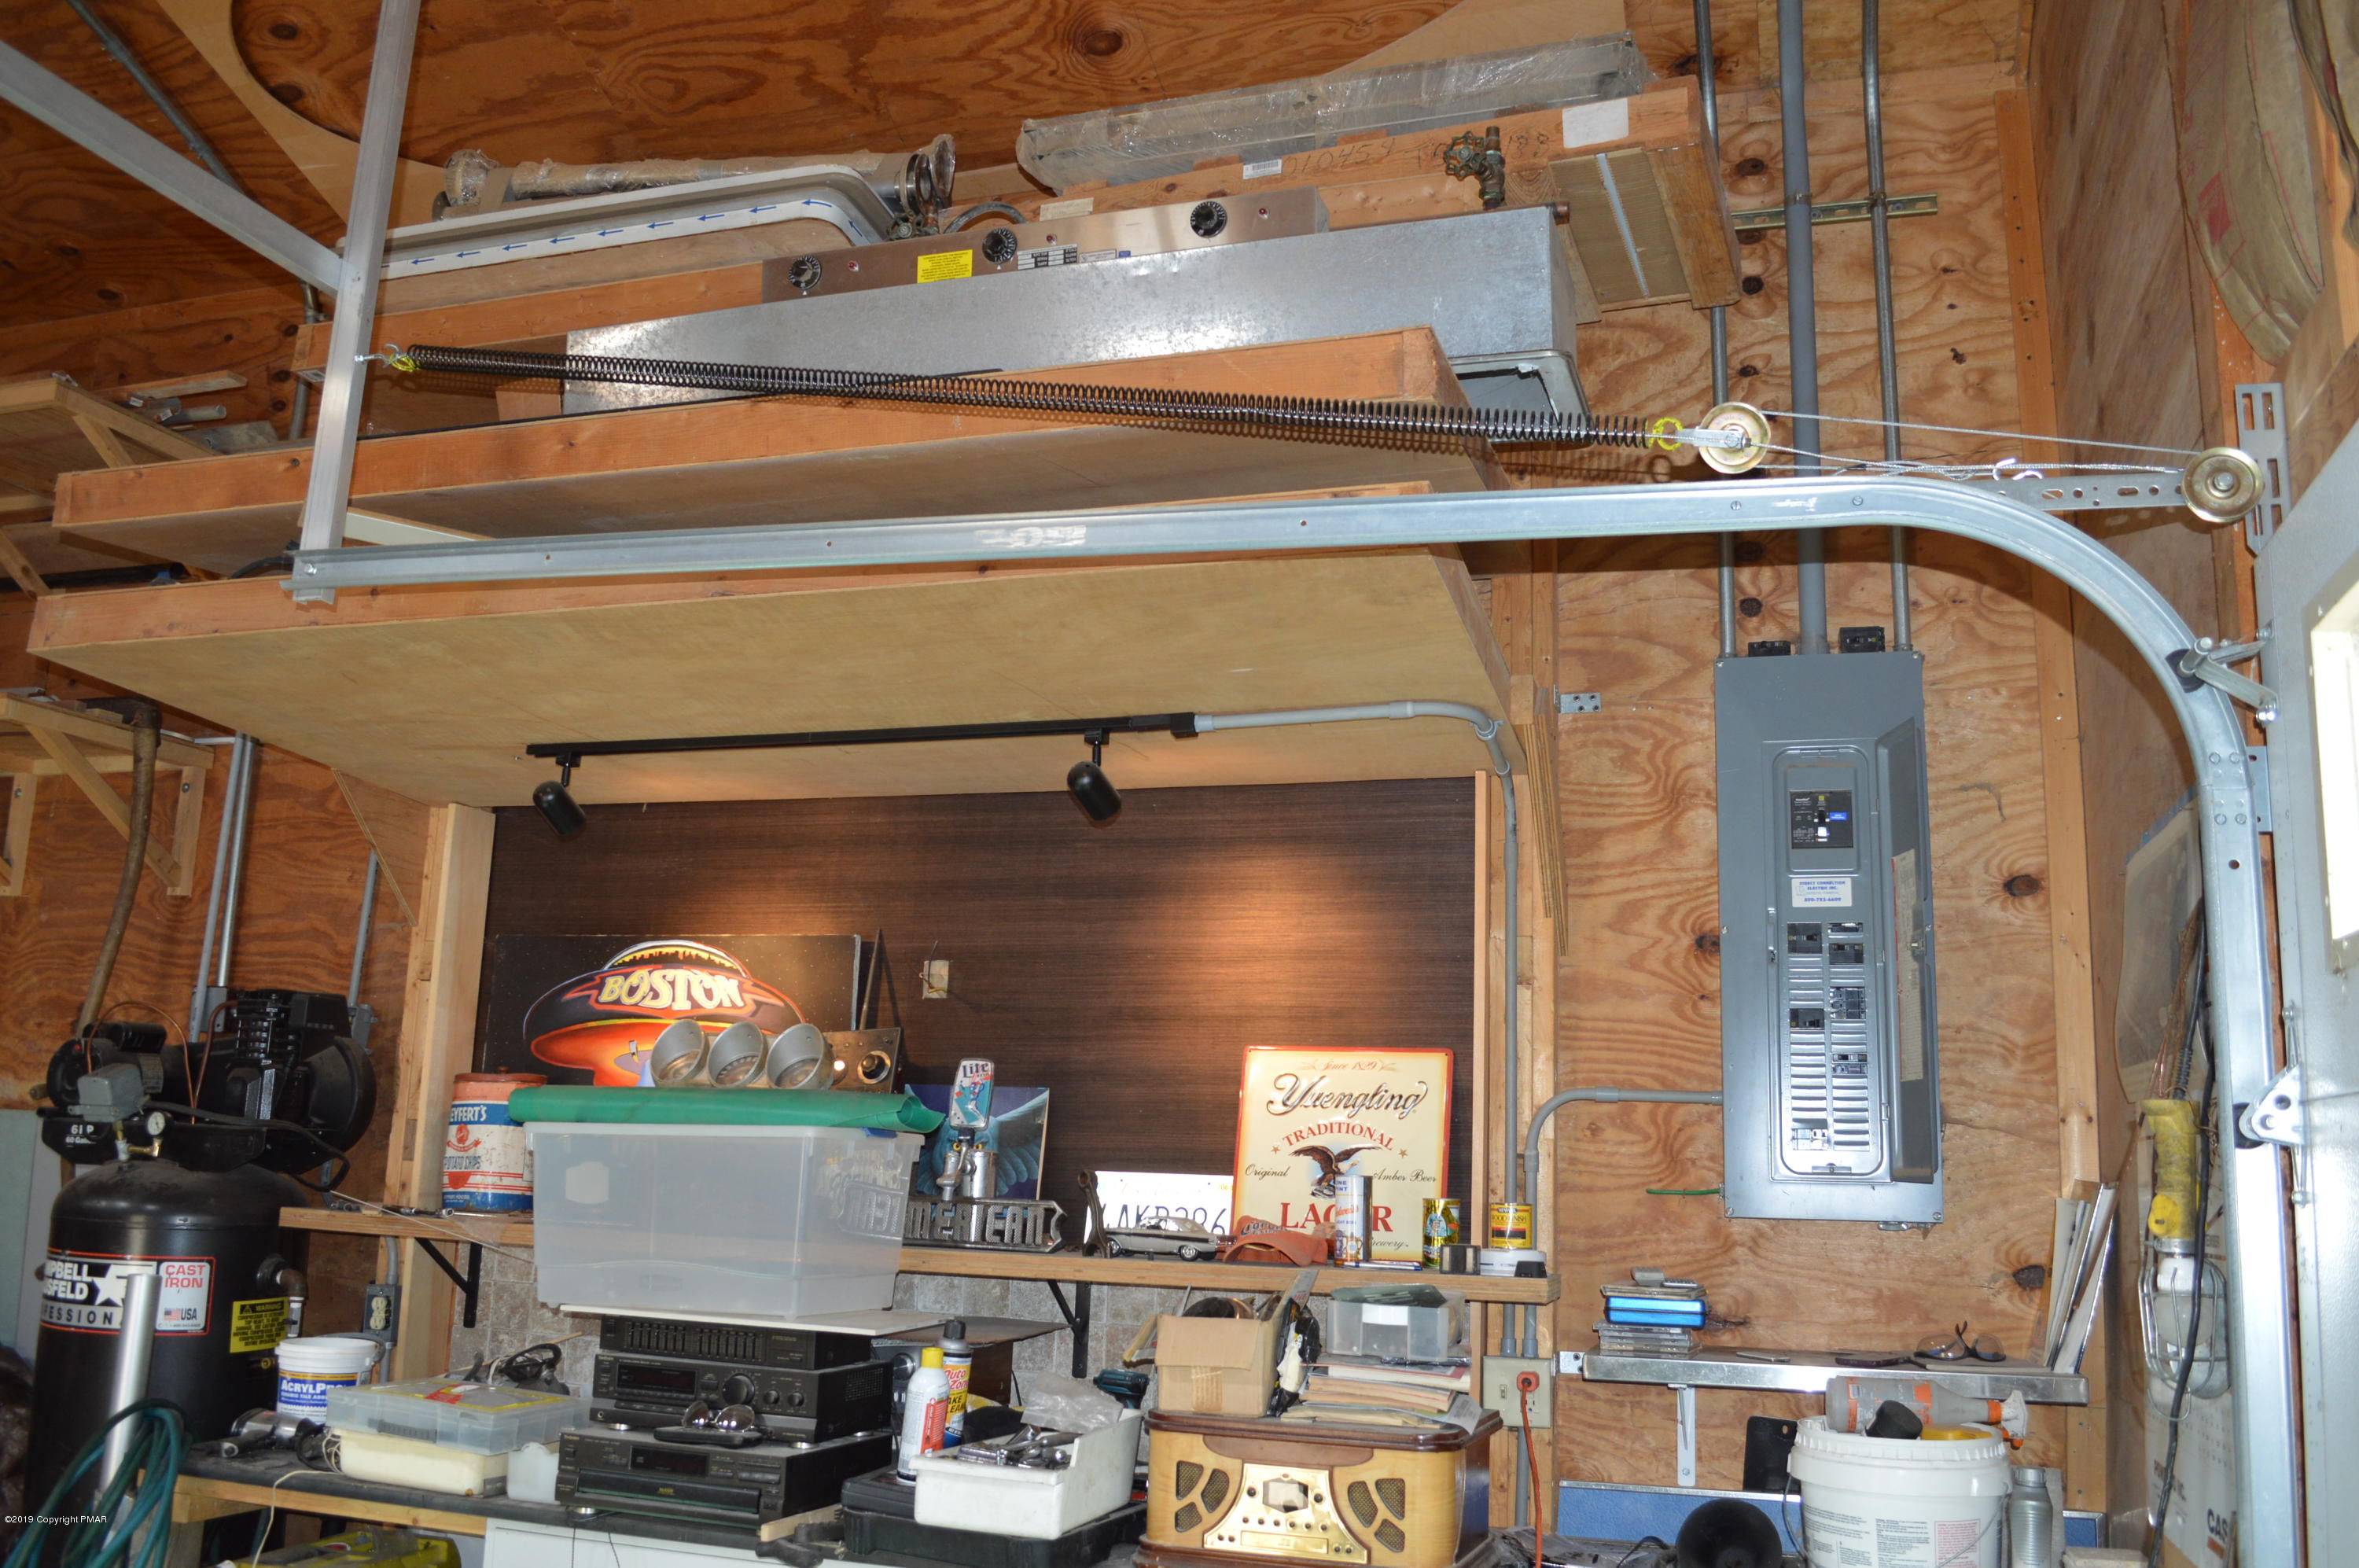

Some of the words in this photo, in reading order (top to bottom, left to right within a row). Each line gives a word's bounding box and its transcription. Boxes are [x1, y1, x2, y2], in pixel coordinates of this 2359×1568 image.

[598, 969, 745, 1010] BOSTON
[962, 1062, 989, 1078] Lite
[1323, 1059, 1349, 1071] Since
[1267, 1073, 1428, 1120] Yuengling
[1283, 1122, 1394, 1150] TRADITIONAL
[1245, 1164, 1290, 1180] Original
[1374, 1169, 1408, 1182] Amber
[1410, 1169, 1437, 1183] Beer
[165, 1264, 205, 1275] CAST
[164, 1277, 203, 1288] IRON
[180, 1308, 197, 1321] USA
